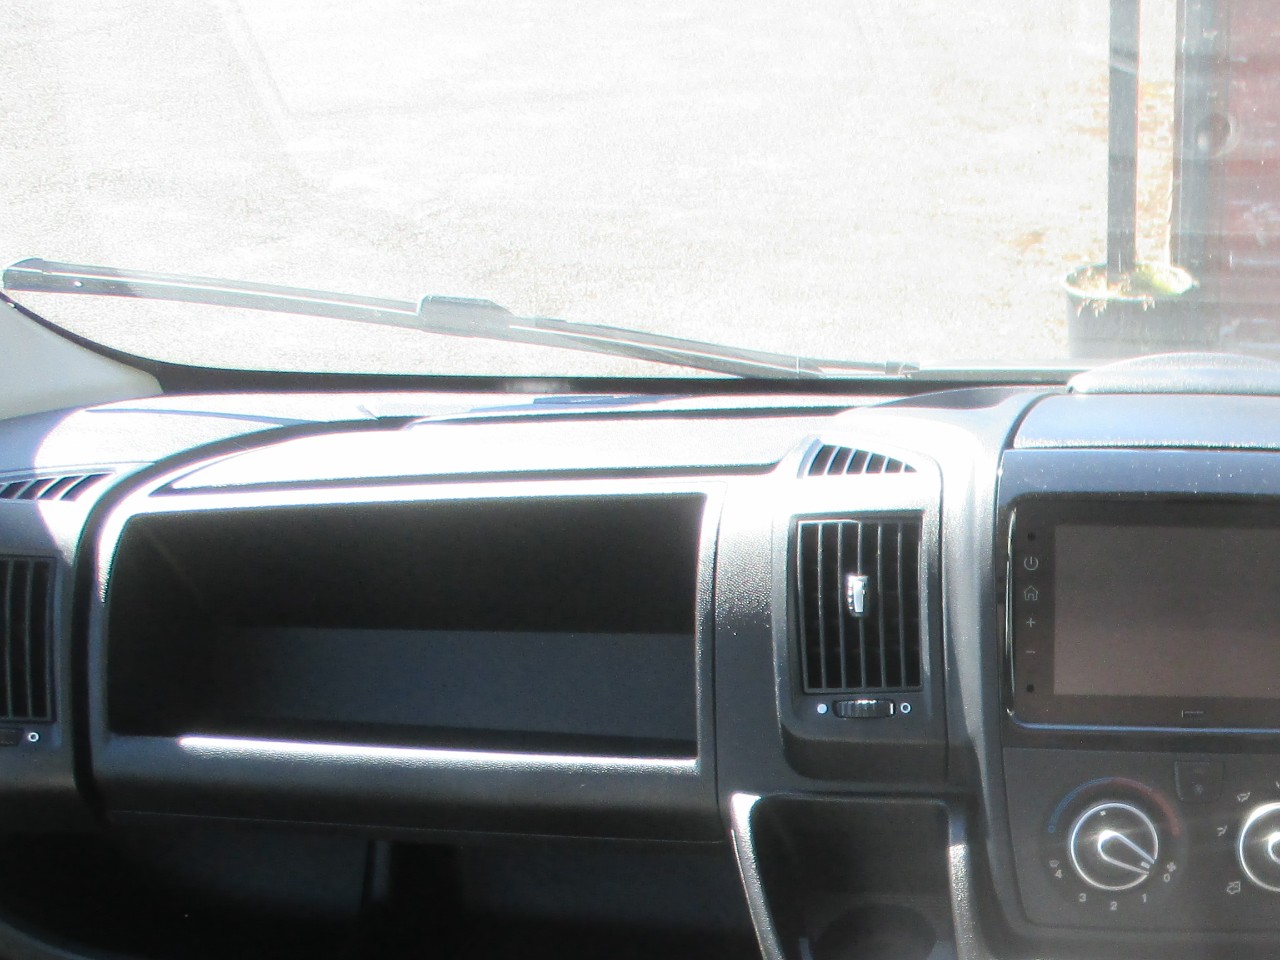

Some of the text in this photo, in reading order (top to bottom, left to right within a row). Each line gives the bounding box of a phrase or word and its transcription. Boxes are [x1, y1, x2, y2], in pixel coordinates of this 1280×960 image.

[1079, 893, 1087, 902] 3
[1142, 893, 1147, 903] 1
[1110, 901, 1118, 911] 2
